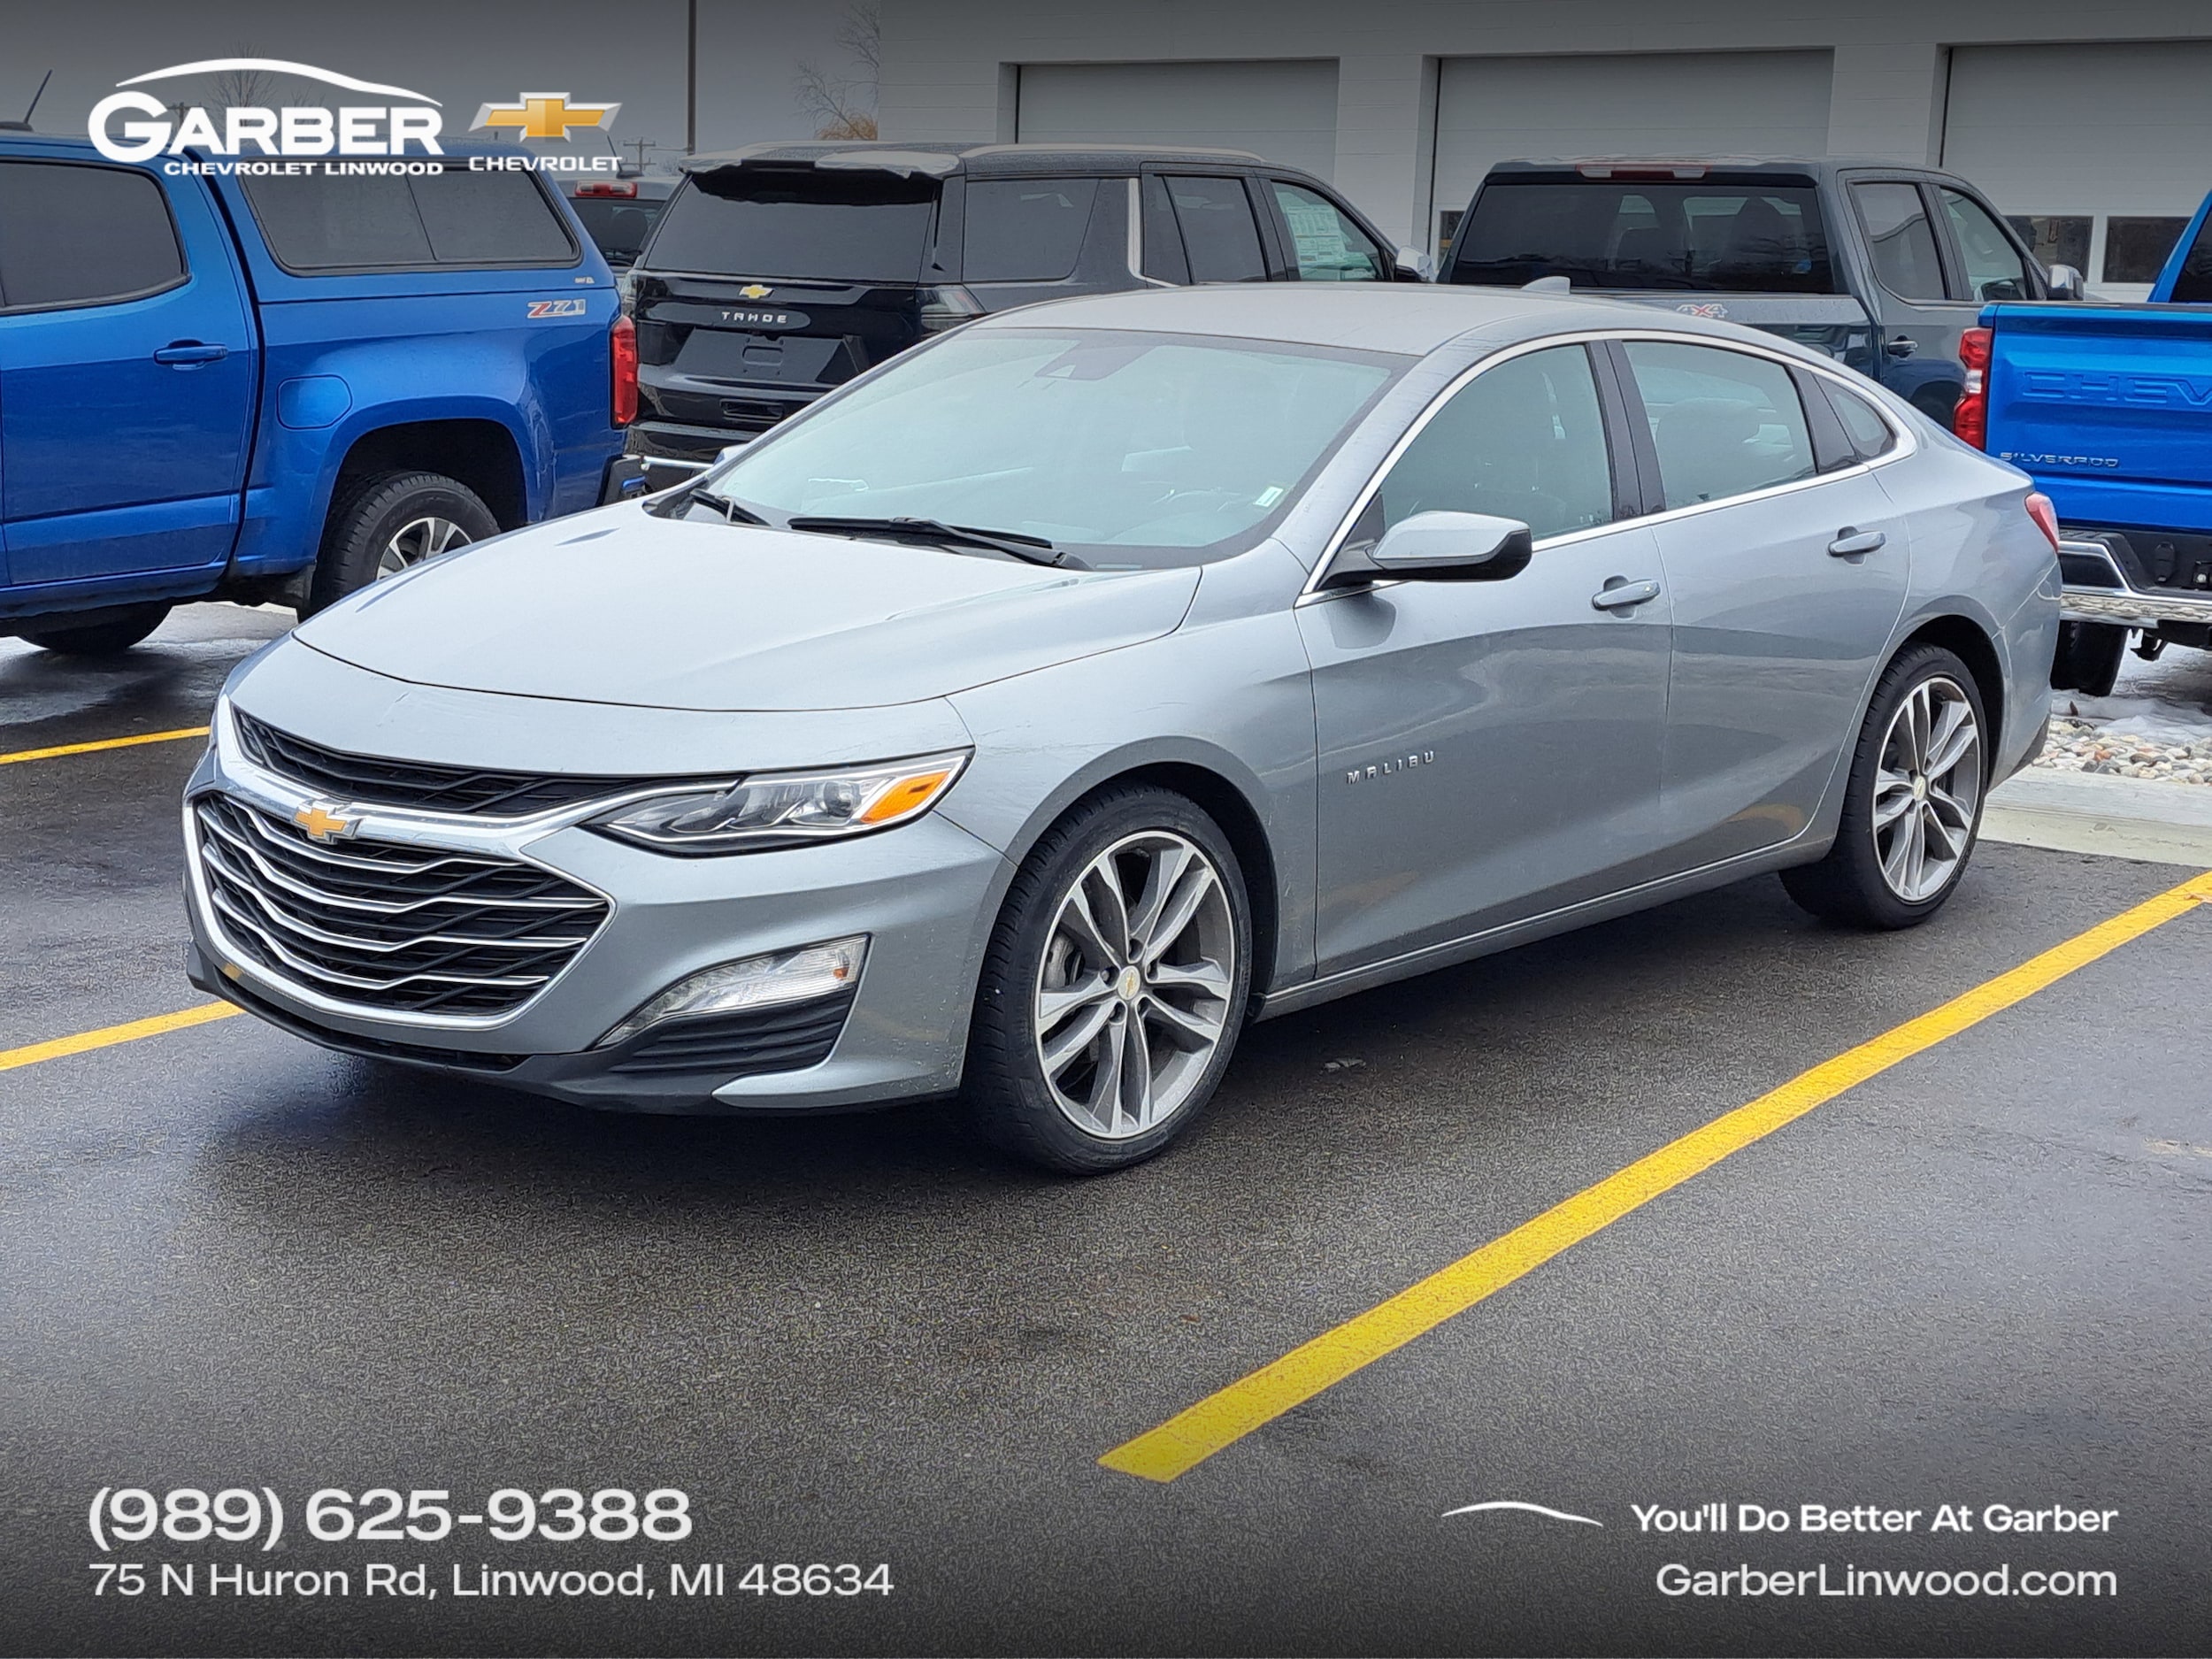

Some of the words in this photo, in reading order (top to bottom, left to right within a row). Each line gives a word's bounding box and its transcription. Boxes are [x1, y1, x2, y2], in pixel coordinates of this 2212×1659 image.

[526, 298, 586, 319] Z71
[721, 311, 787, 324] TAHOE
[2000, 451, 2119, 467] SILVERADO
[1347, 750, 1434, 784] MALIBU
